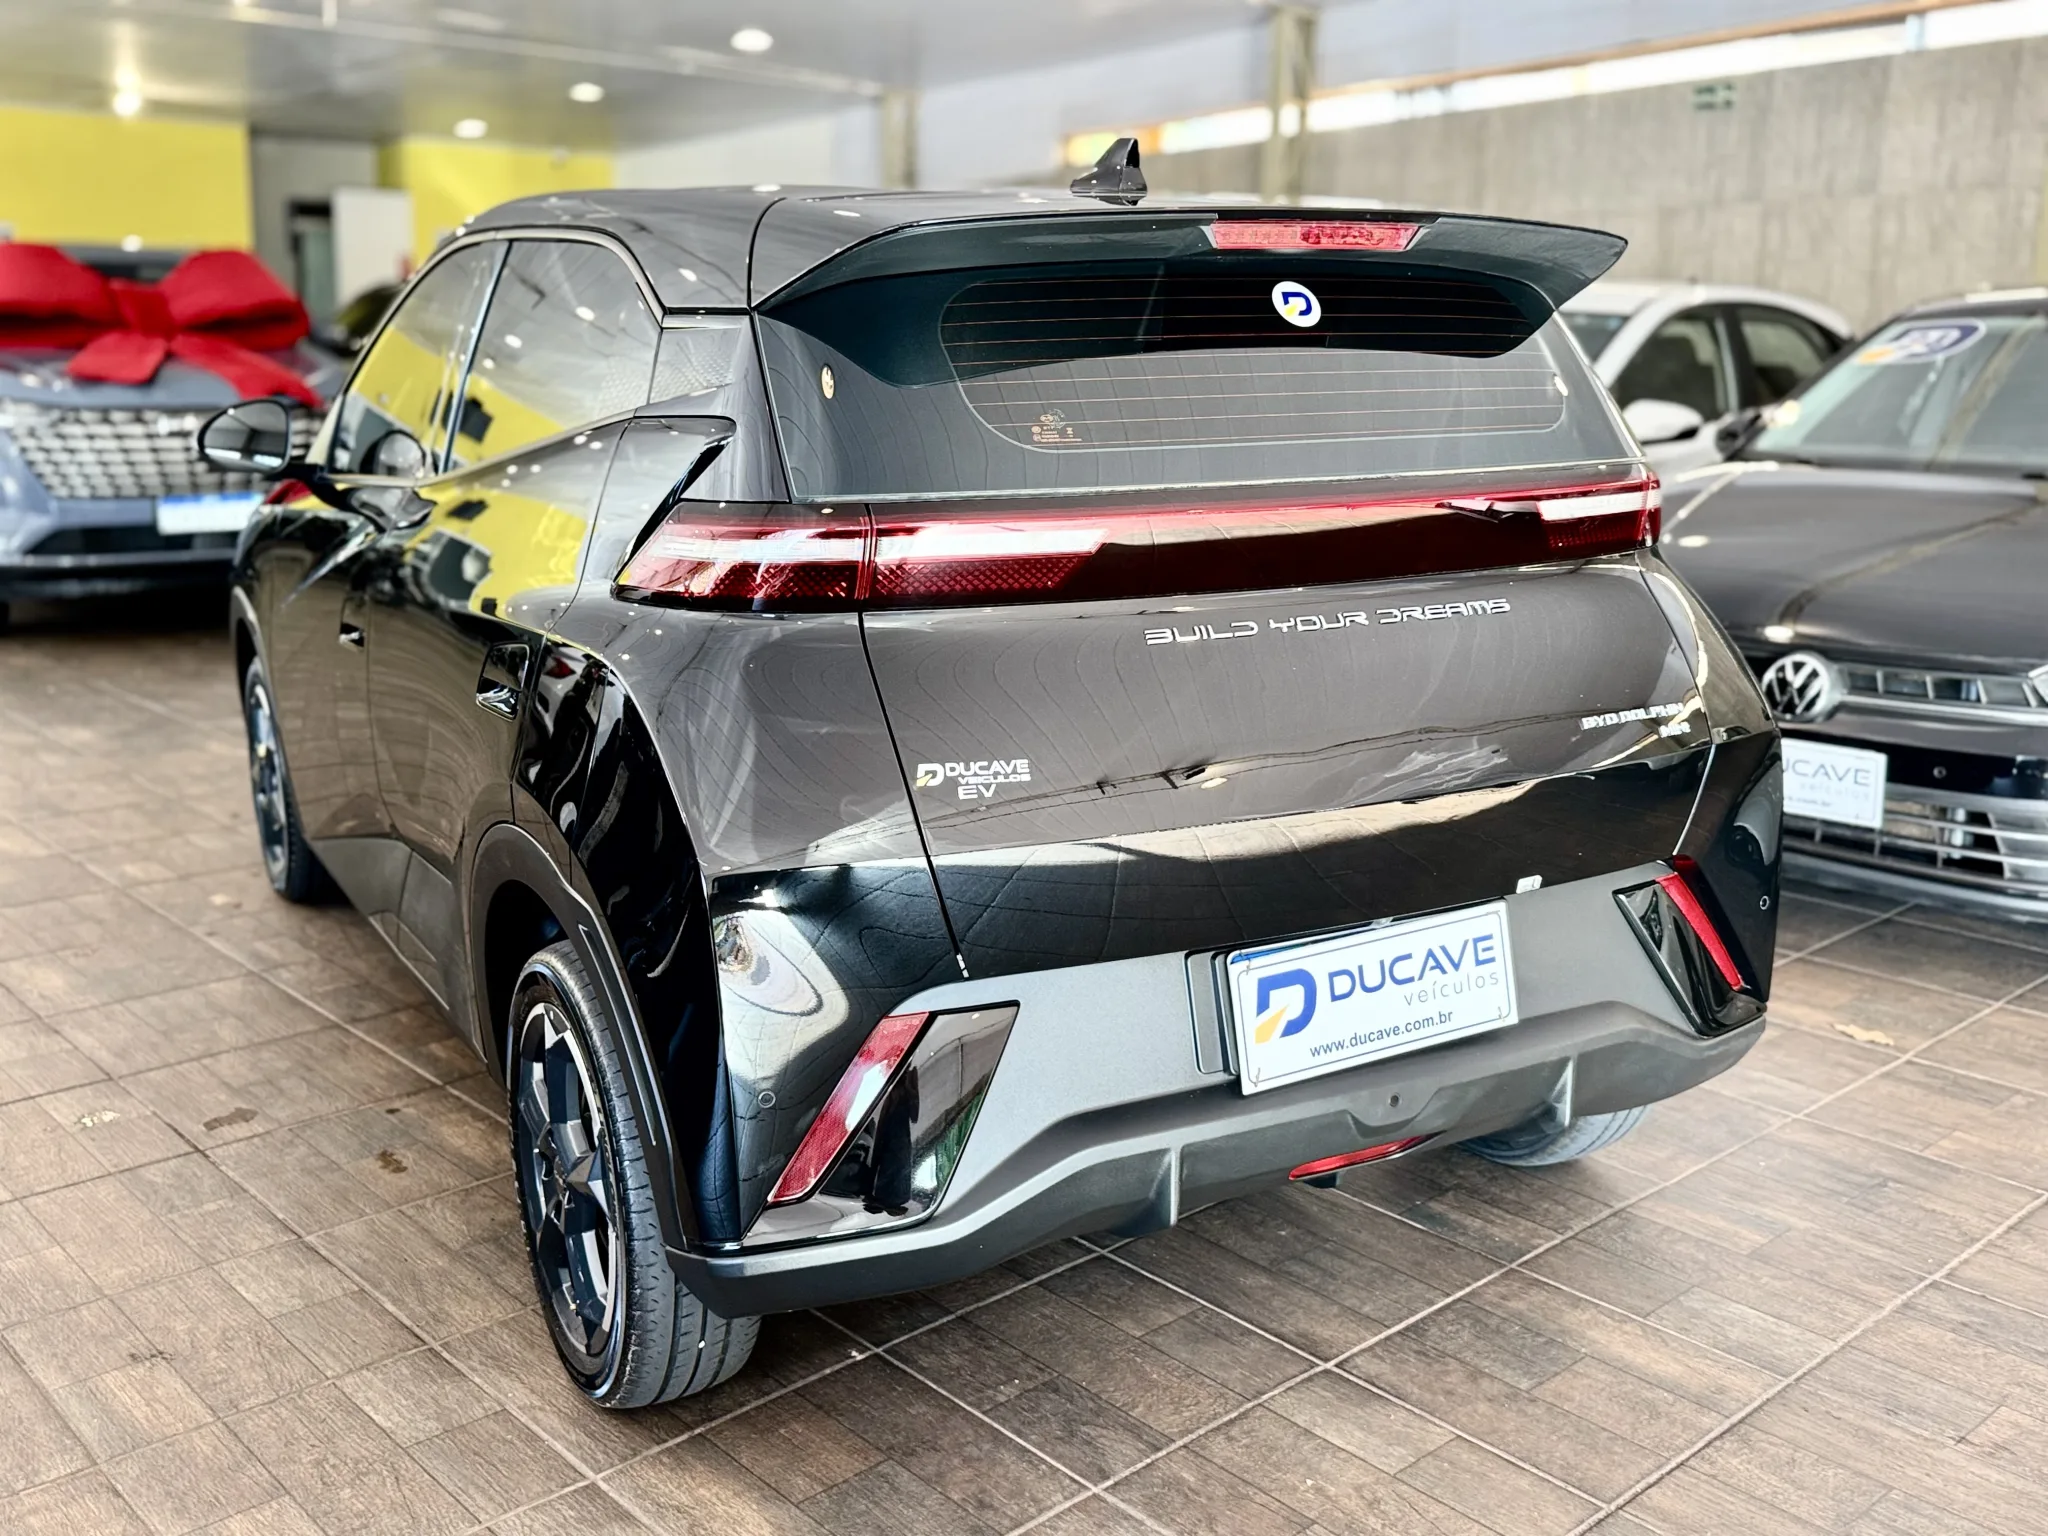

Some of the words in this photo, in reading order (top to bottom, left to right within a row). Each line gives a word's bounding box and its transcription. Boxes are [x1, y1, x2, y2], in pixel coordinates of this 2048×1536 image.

[1144, 621, 1259, 645] BUILD
[1269, 611, 1369, 634] YOUR
[1376, 598, 1511, 624] DREAMS
[1580, 713, 1618, 730] BYD
[1619, 702, 1685, 724] DOLPHIN
[945, 759, 1029, 776] DUCAVE
[957, 784, 996, 800] EV
[1328, 933, 1497, 1003] DUCAVE
[1404, 972, 1499, 1006] veículos
[1309, 1010, 1454, 1058] www.ducave.com.br
